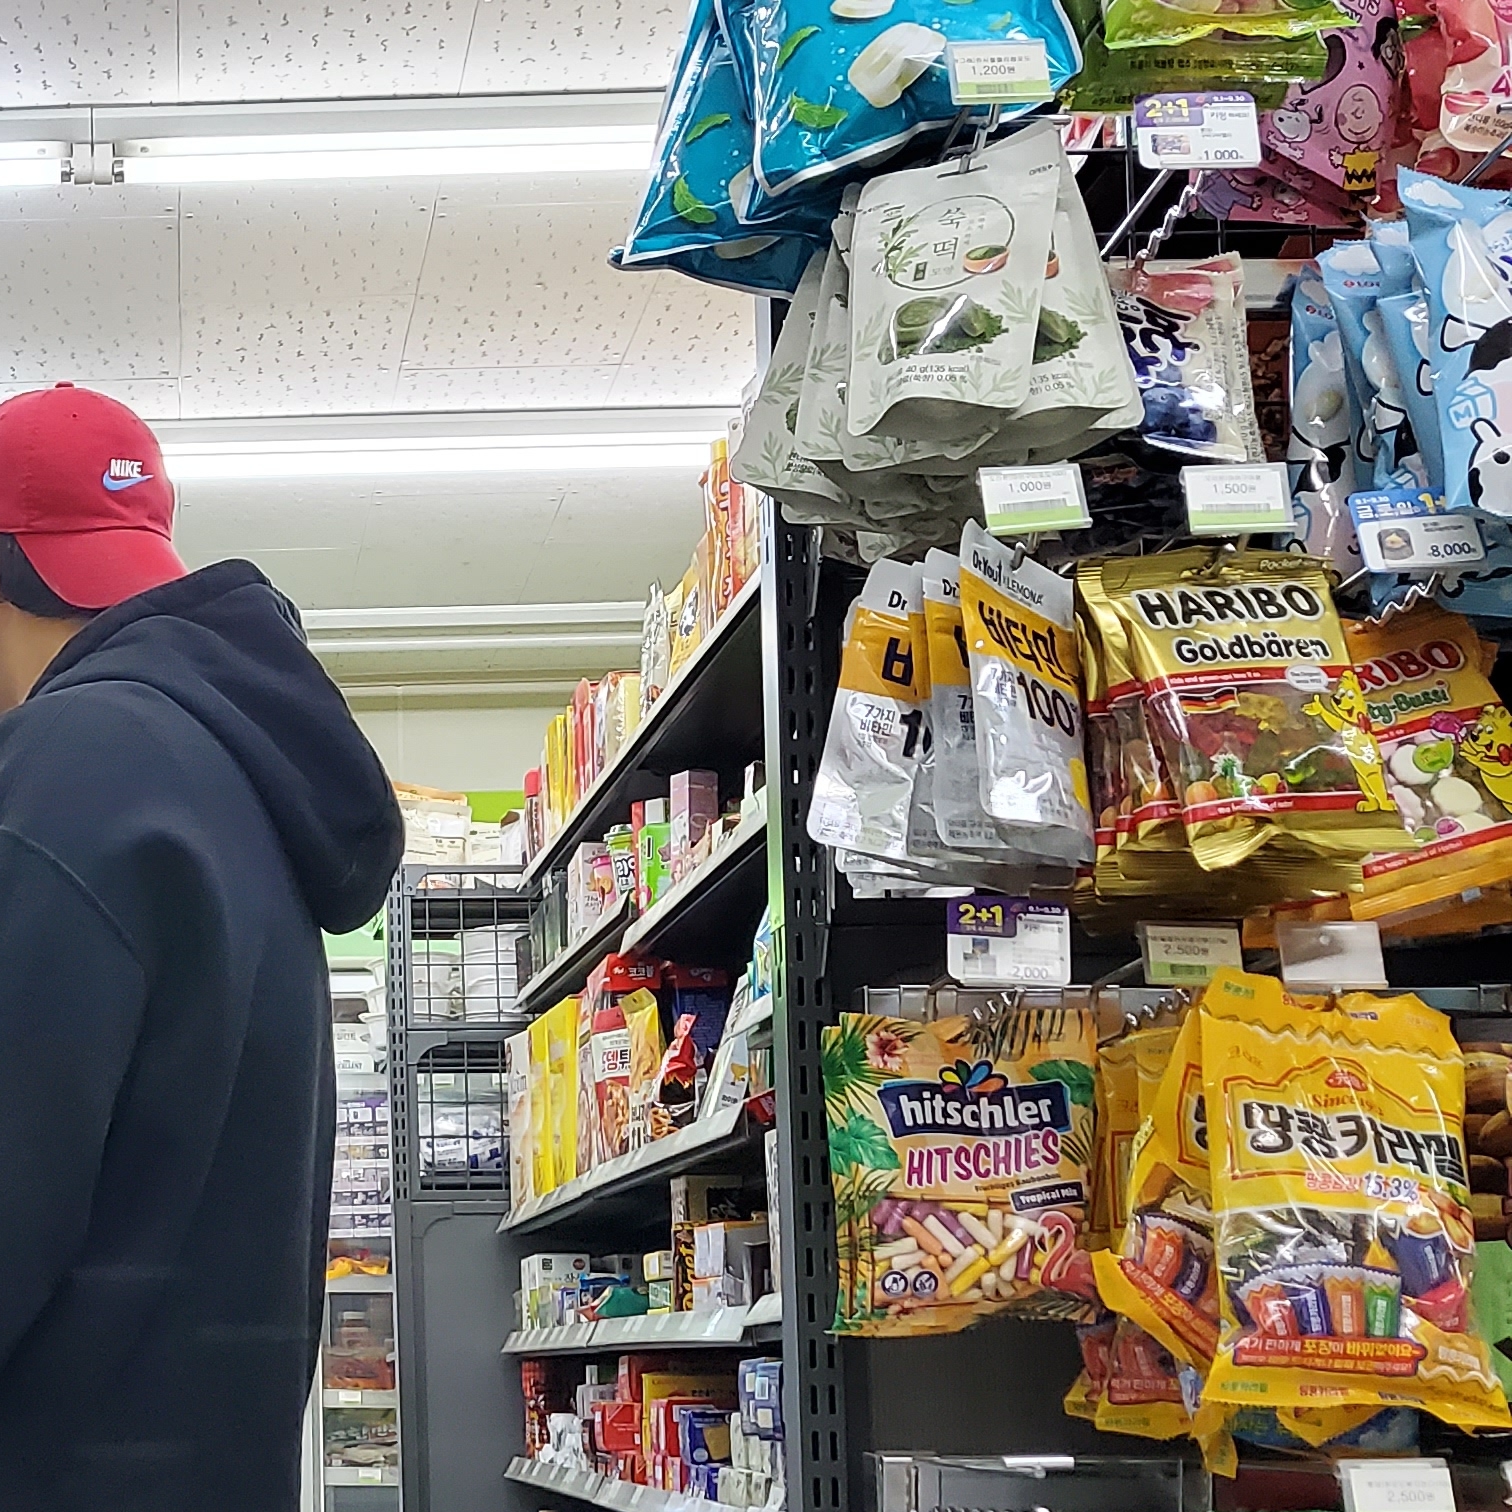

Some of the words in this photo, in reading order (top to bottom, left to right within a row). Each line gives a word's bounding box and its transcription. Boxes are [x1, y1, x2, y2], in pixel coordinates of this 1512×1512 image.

[972, 65, 1016, 76] 1,200원
[1144, 98, 1189, 118] 2+1
[109, 458, 143, 478] NIKE
[1008, 480, 1052, 492] 1,000원
[1212, 482, 1256, 494] 1,500원
[1432, 542, 1471, 559] 8,000
[1135, 583, 1322, 628] HARIBO
[1175, 632, 1331, 665] Goldbären
[1355, 641, 1462, 690] RIBO
[1017, 671, 1077, 738] 100
[958, 903, 1003, 926] 2+1
[1012, 966, 1049, 980] 2,000
[898, 1091, 1052, 1129] hitschler
[1243, 1101, 1467, 1188] 땅콩카라멜
[906, 1129, 1060, 1187] HITSCHIES
[1019, 1189, 1060, 1205] Tropical
[1364, 1172, 1419, 1201] 15.3%
